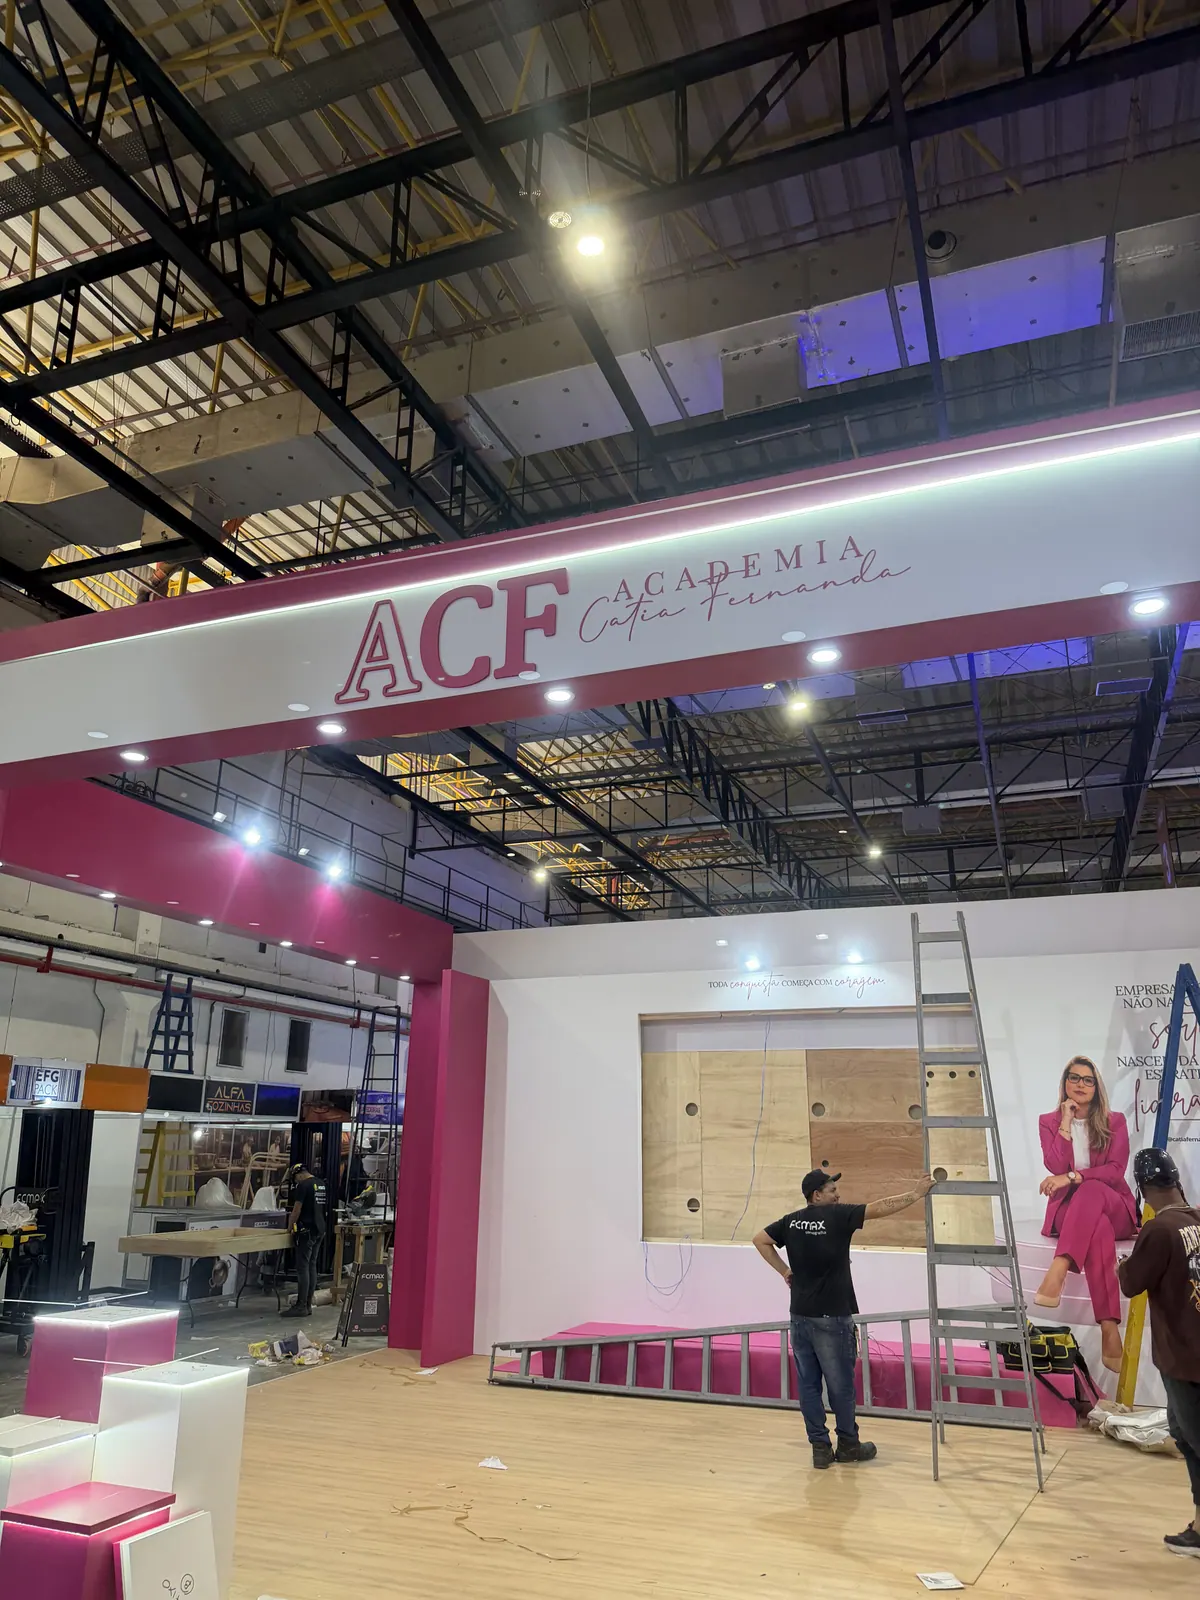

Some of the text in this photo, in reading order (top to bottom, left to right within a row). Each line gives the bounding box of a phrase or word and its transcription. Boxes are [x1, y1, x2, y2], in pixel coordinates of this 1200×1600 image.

[612, 535, 864, 603] ACADEMIA
[578, 549, 912, 643] Catia Fernanda
[334, 567, 569, 704] ACF
[707, 981, 729, 989] TODA
[729, 971, 784, 1000] conquista
[781, 979, 814, 988] COMEÇA
[814, 978, 833, 986] COM
[1123, 996, 1153, 1009] NÃO
[36, 1069, 59, 1082] EFG
[35, 1084, 58, 1095] PACK
[214, 1085, 245, 1100] ALFA
[789, 1220, 826, 1231] FCMAX
